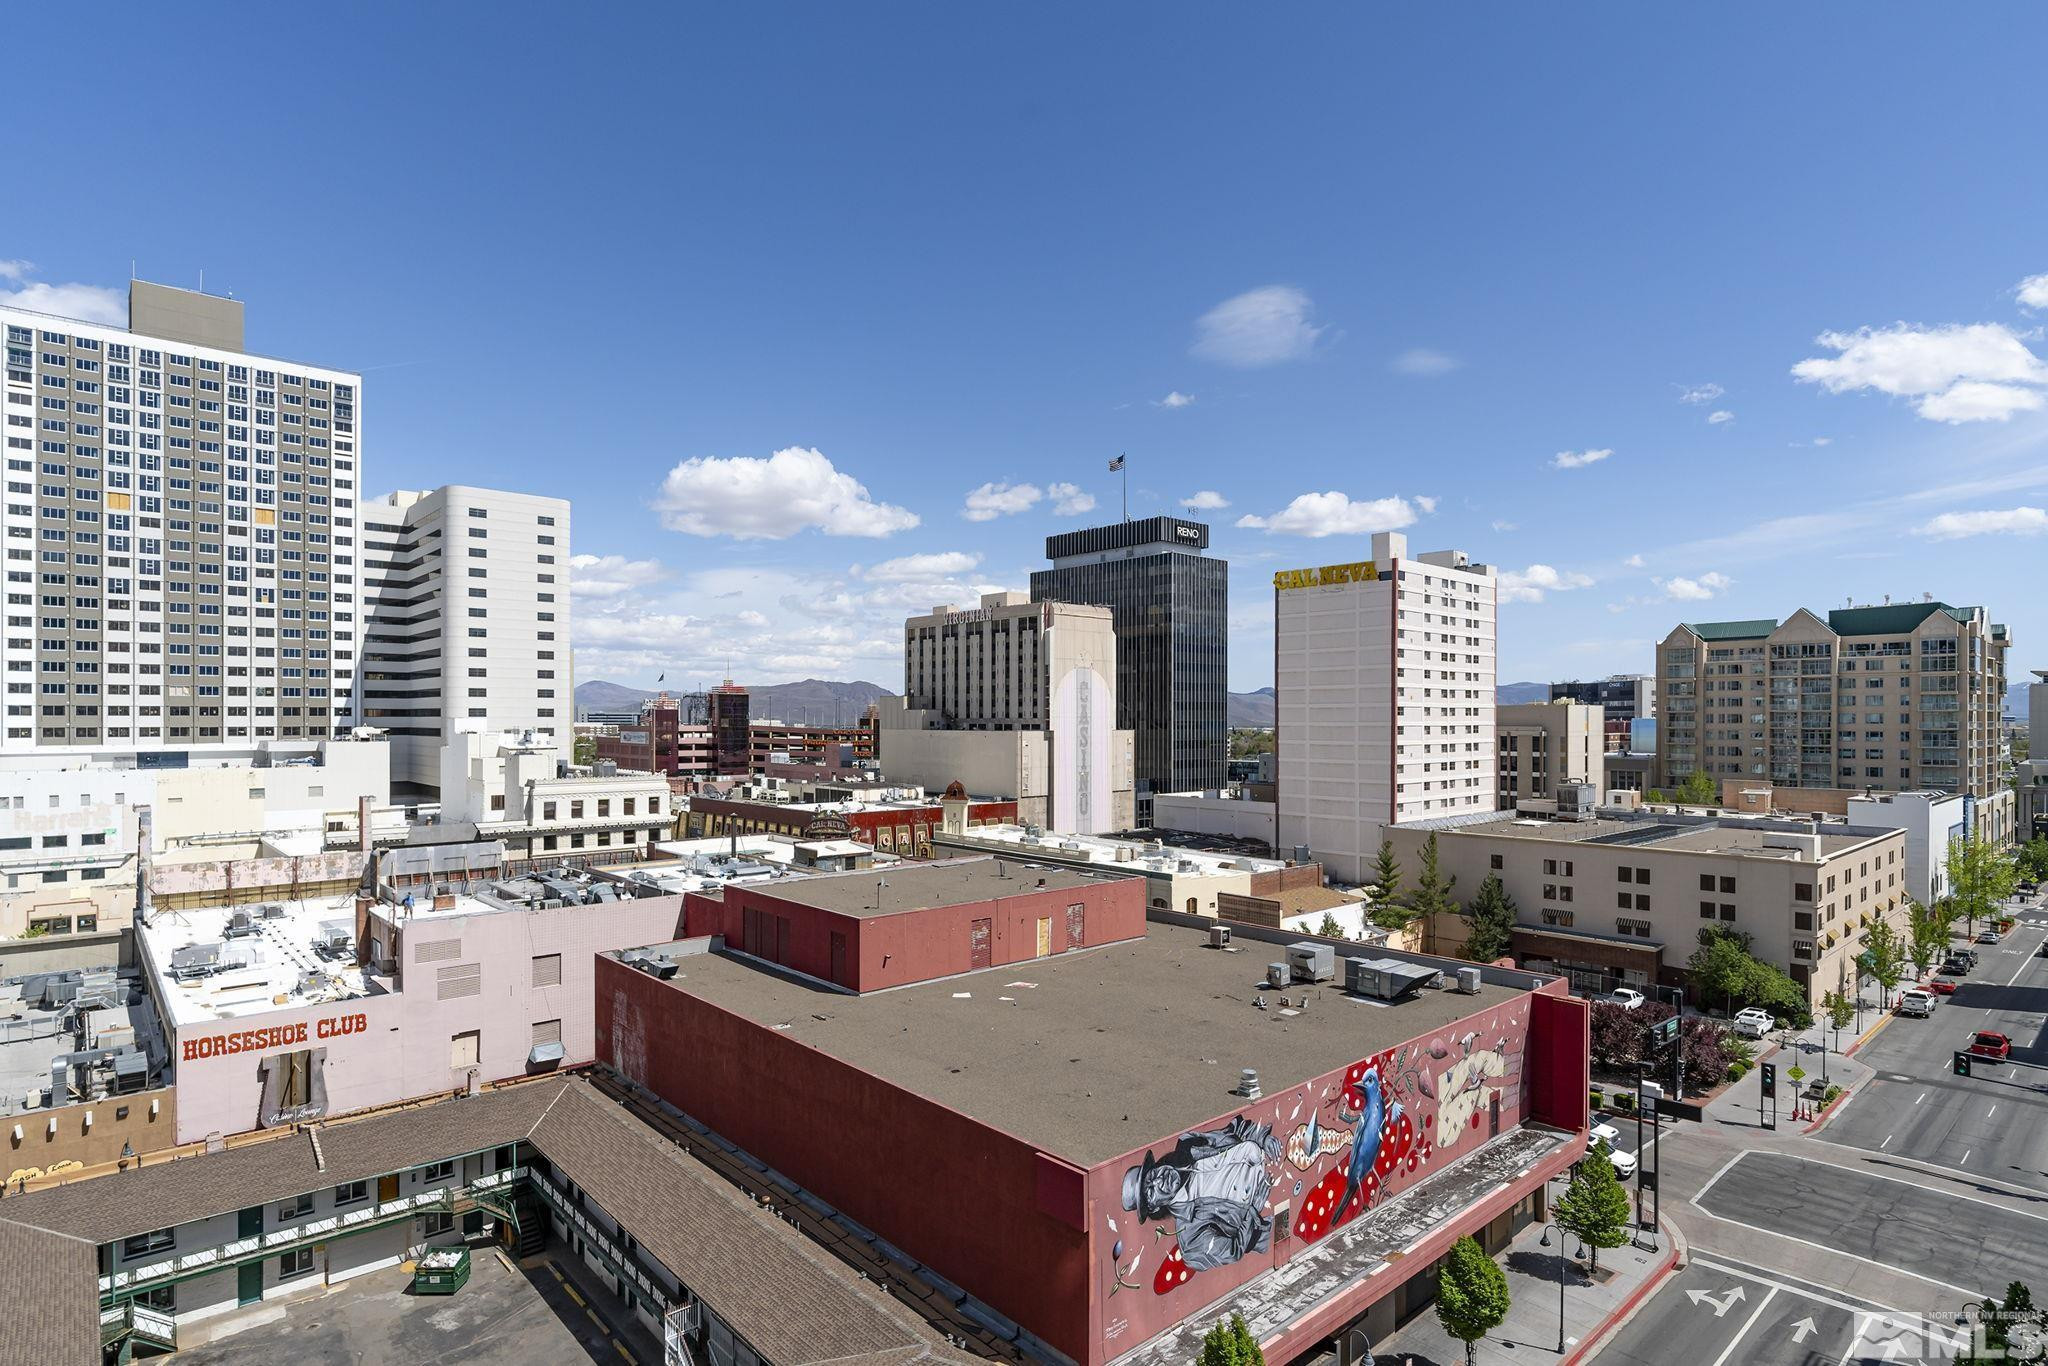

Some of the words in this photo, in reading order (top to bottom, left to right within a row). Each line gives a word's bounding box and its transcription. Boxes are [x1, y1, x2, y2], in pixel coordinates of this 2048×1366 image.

[1177, 526, 1199, 538] RENO
[1274, 569, 1318, 591] CAL
[1319, 561, 1378, 585] NEVA
[944, 607, 993, 625] VIRGINIAN
[1079, 680, 1089, 815] CASINO
[811, 820, 826, 829] CAL
[828, 820, 846, 830] NEVA
[183, 1022, 308, 1061] HORSESHOE
[316, 1013, 367, 1039] CLUB
